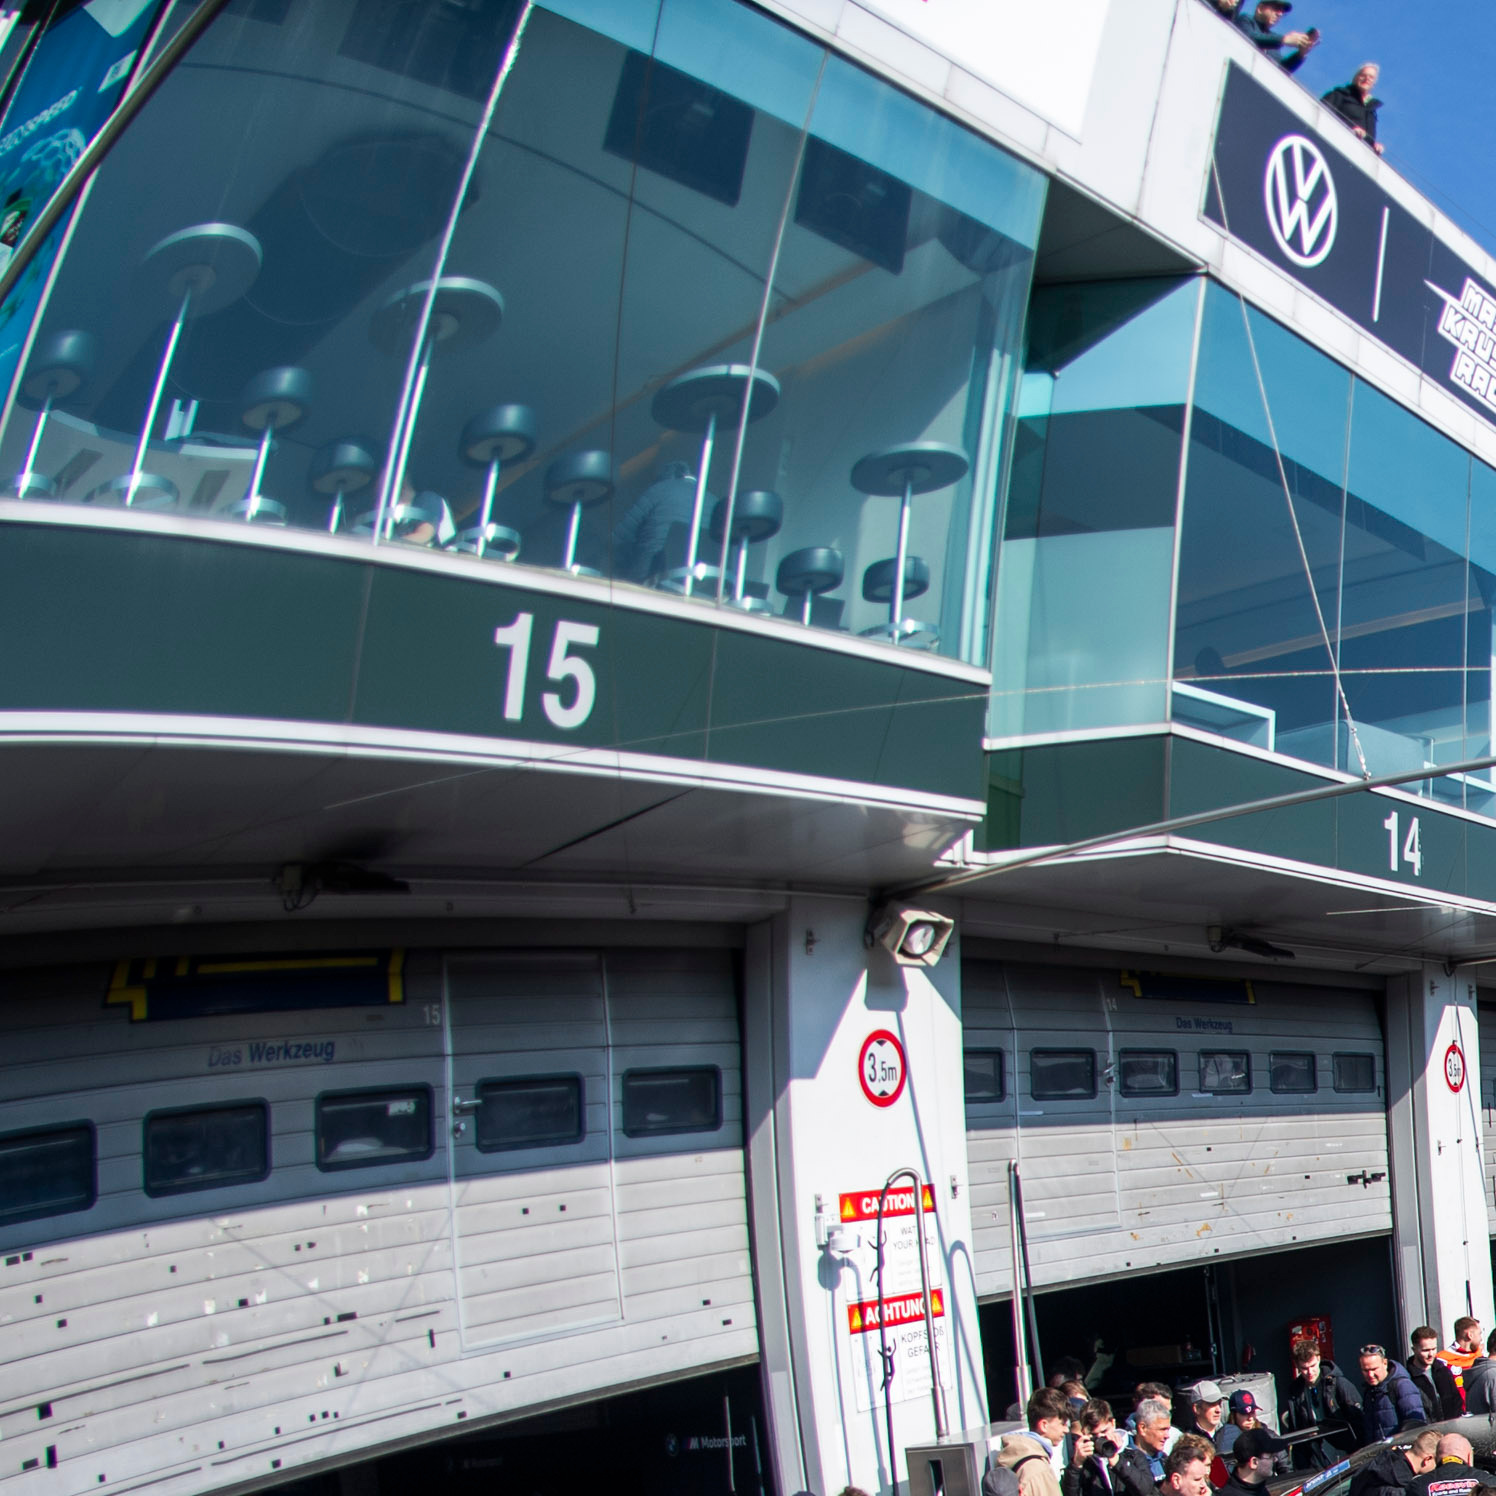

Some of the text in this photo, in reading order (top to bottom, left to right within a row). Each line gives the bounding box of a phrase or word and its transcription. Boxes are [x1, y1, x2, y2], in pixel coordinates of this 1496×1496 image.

[494, 612, 601, 729] 15
[1384, 811, 1422, 877] 14
[423, 1004, 441, 1026] 15
[1175, 1016, 1233, 1034] Das Werkzeug
[207, 1040, 336, 1068] Das Werkzeug
